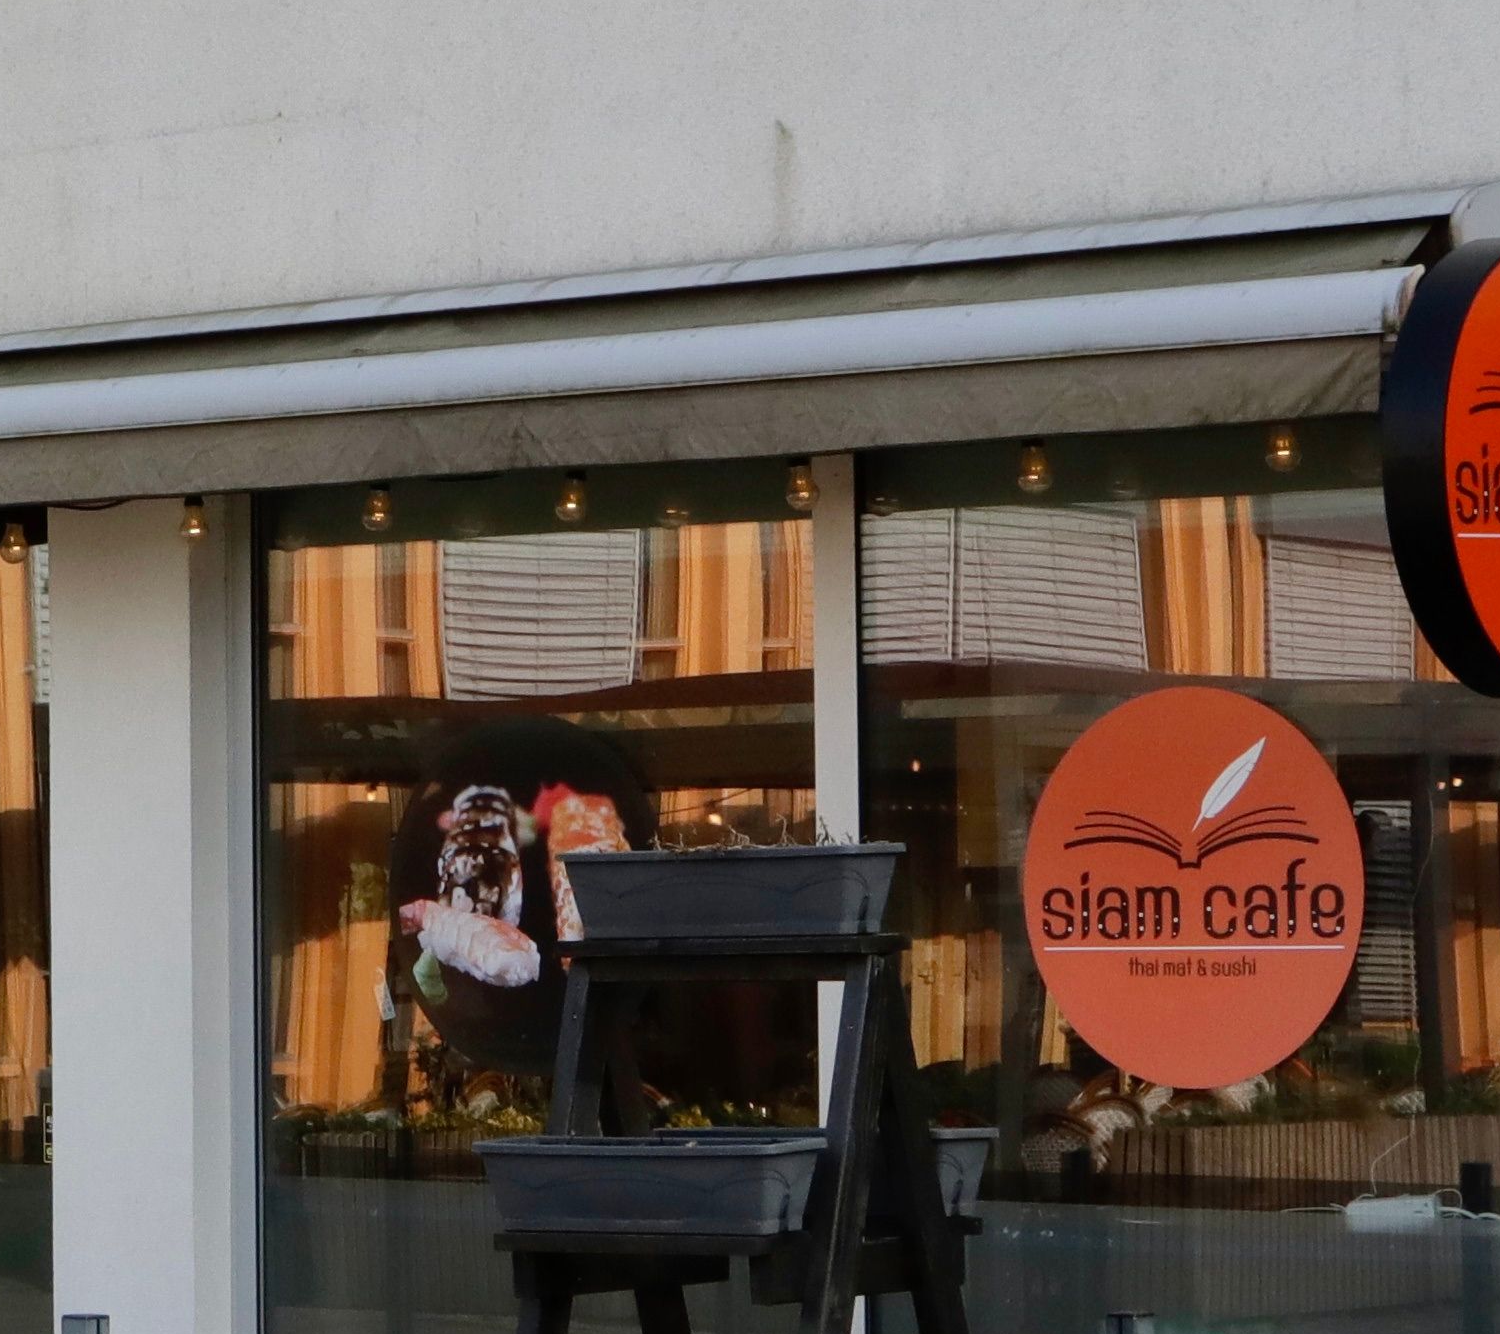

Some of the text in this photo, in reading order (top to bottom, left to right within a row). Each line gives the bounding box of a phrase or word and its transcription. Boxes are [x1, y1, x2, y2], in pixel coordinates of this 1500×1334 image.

[1041, 857, 1346, 941] siam cafe
[1128, 954, 1257, 977] thai mat & sushi
